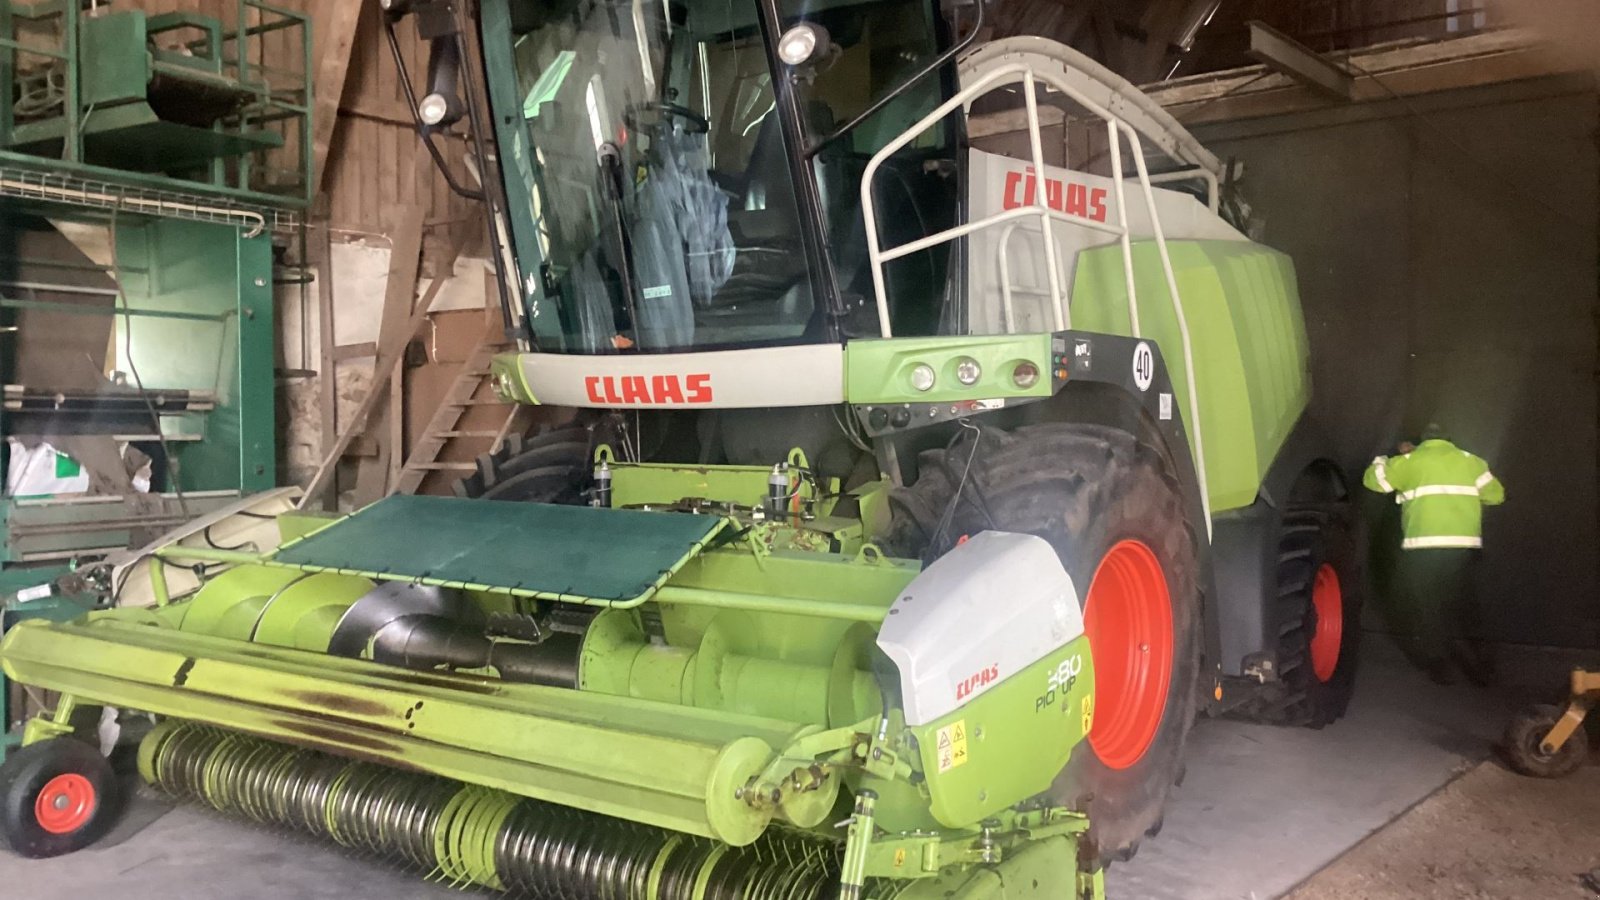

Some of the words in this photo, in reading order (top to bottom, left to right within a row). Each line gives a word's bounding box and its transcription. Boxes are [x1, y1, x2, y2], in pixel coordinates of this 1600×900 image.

[1136, 350, 1150, 381] 40
[585, 374, 712, 404] CLAAS
[957, 662, 998, 701] CLAAS
[1062, 675, 1076, 695] UP
